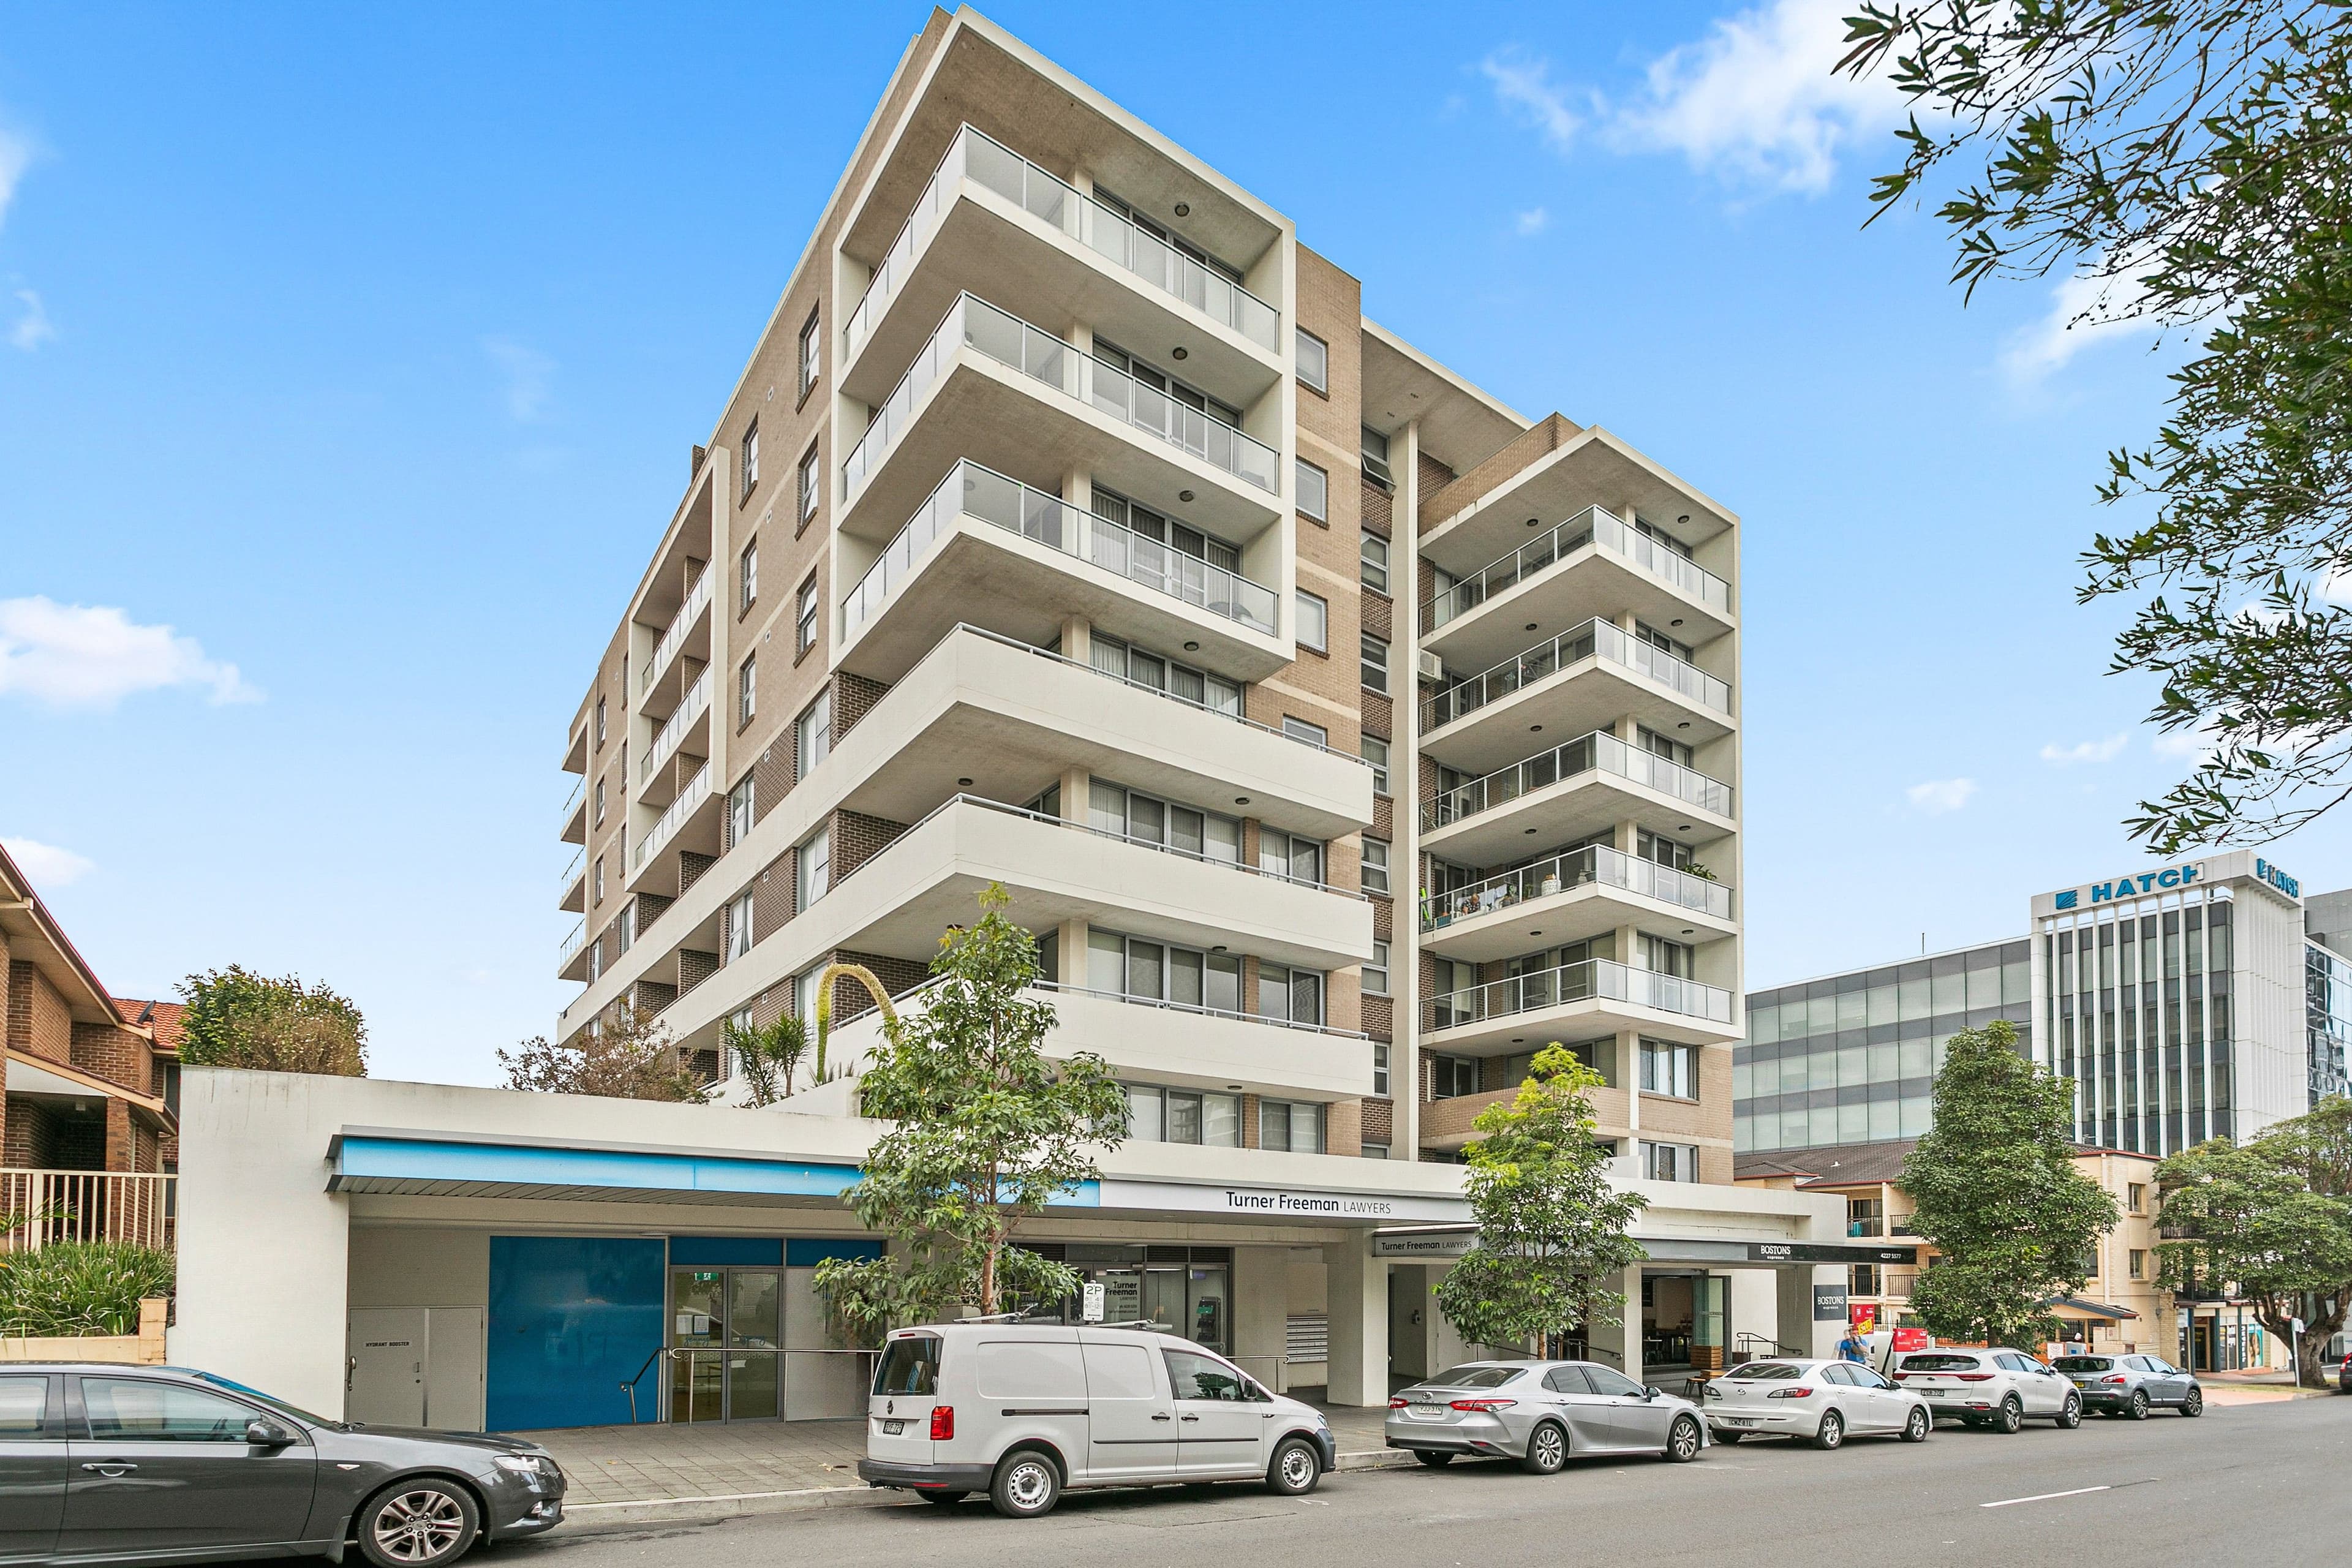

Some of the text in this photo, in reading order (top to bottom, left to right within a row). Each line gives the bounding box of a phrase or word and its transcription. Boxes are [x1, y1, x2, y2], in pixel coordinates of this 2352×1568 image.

[2092, 862, 2204, 903] HATCH
[1226, 1191, 1391, 1214] Turner Freeman LAWYERS
[1407, 1241, 1440, 1250] Freeman
[1760, 1245, 1791, 1255] BOSTONS
[1087, 1286, 1102, 1295] 2P
[1817, 1296, 1844, 1305] BOSTONS
